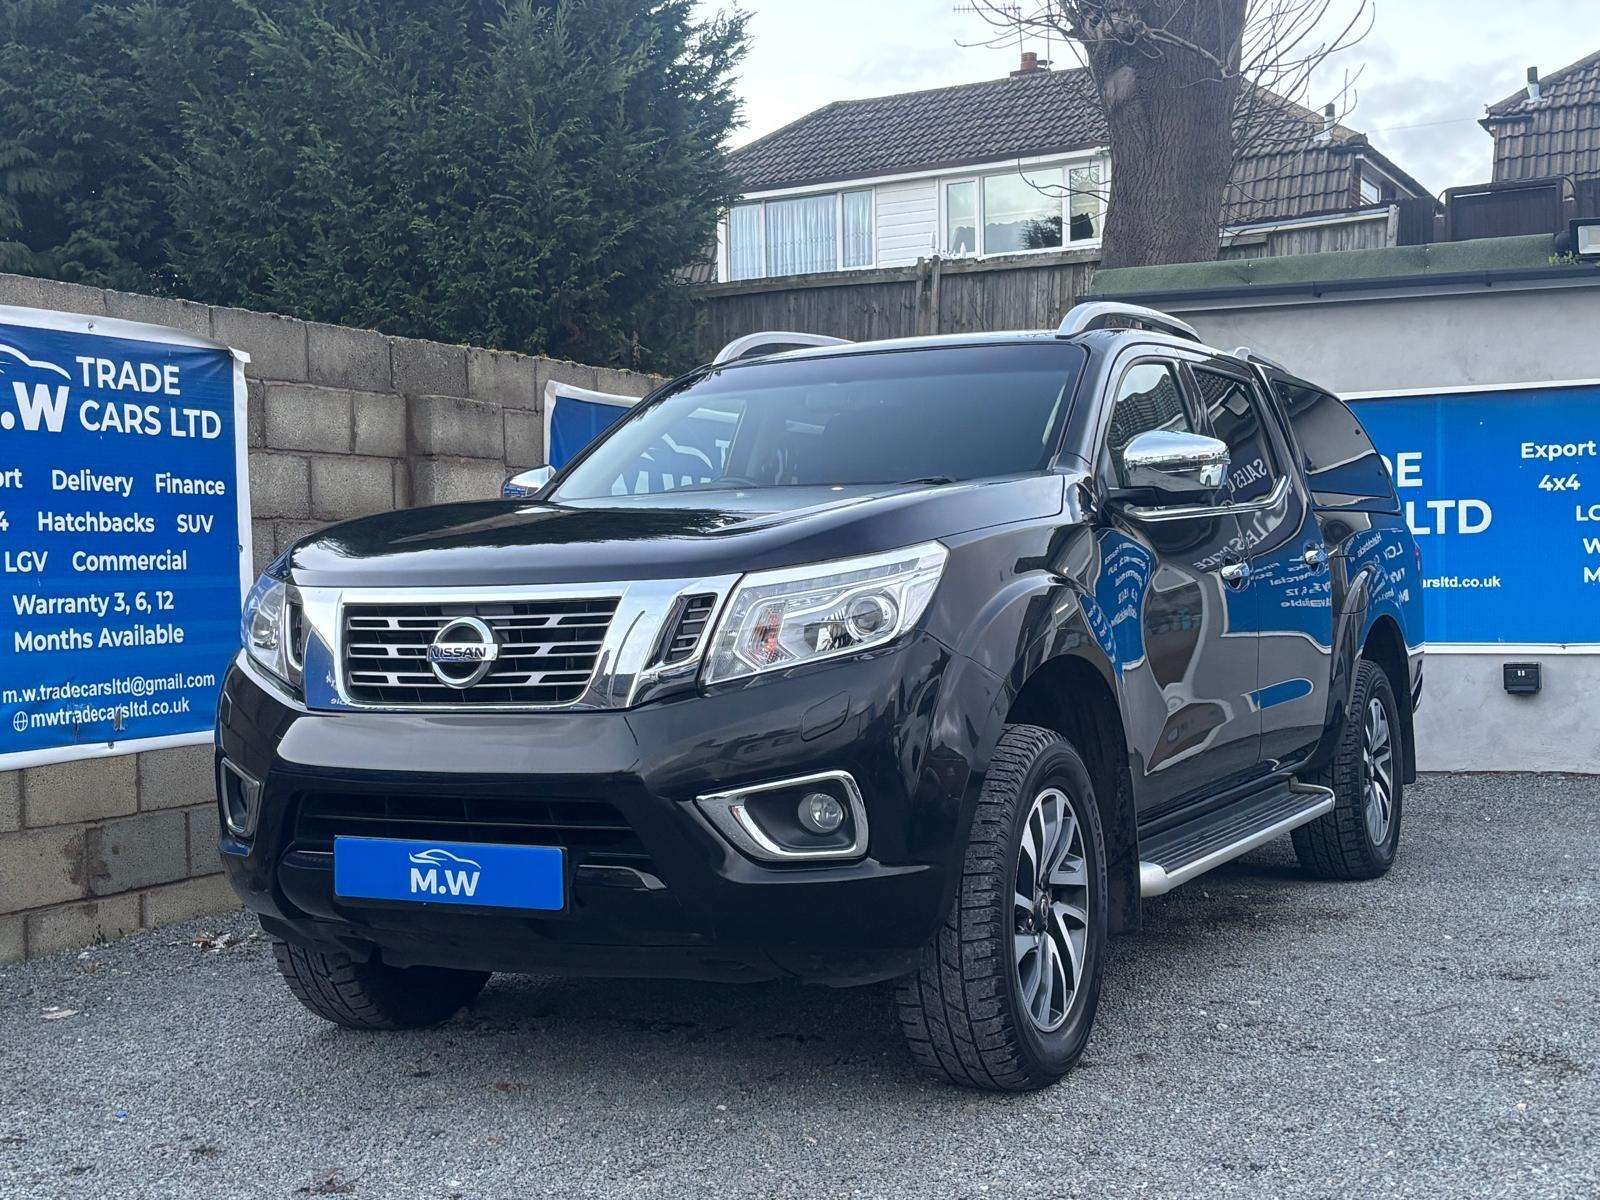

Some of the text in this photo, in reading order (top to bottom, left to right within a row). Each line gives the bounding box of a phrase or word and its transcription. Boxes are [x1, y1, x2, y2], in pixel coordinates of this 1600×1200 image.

[75, 356, 181, 396] TRADE
[79, 400, 222, 439] CARS LTD
[1521, 440, 1597, 462] Export
[51, 469, 134, 498] Delivery
[155, 473, 226, 496] Finance
[1538, 473, 1581, 492] 4x4
[37, 511, 155, 533] Hatchbacks
[176, 514, 214, 534] SUV
[1405, 499, 1493, 535] LTD
[4, 549, 187, 573] LGV Commercial
[12, 591, 175, 618] Warranty 3, 6, 12
[14, 624, 185, 653] Months Available
[430, 645, 487, 658] NISSAN
[2, 673, 215, 704] m.w.tradecarsltd@gmail.com
[31, 696, 190, 729] mwtradecarsltd.co.uk
[410, 868, 481, 897] M.W
